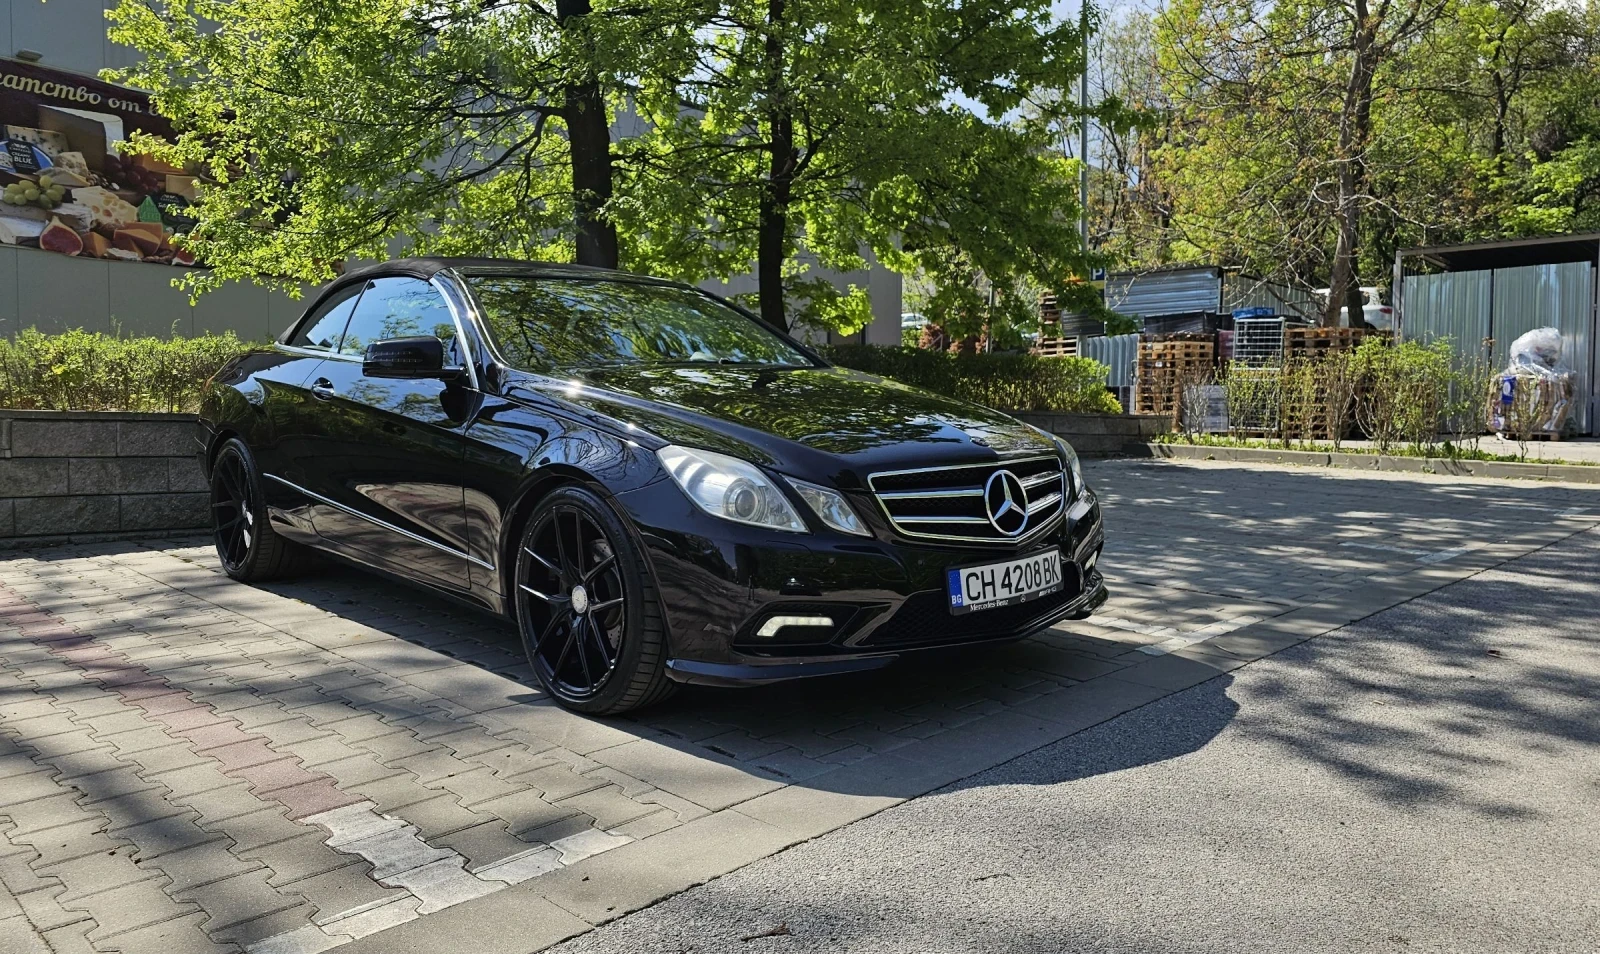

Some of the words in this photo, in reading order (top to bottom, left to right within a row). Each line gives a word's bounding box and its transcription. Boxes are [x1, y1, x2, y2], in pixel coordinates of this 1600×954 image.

[108, 97, 142, 113] от
[14, 156, 33, 165] BLUE
[1092, 268, 1103, 280] P
[966, 569, 997, 601] CH
[1000, 562, 1042, 595] 4208
[1043, 554, 1060, 586] BK
[951, 594, 963, 605] BG
[970, 599, 1009, 611] Mercedes-Benz
